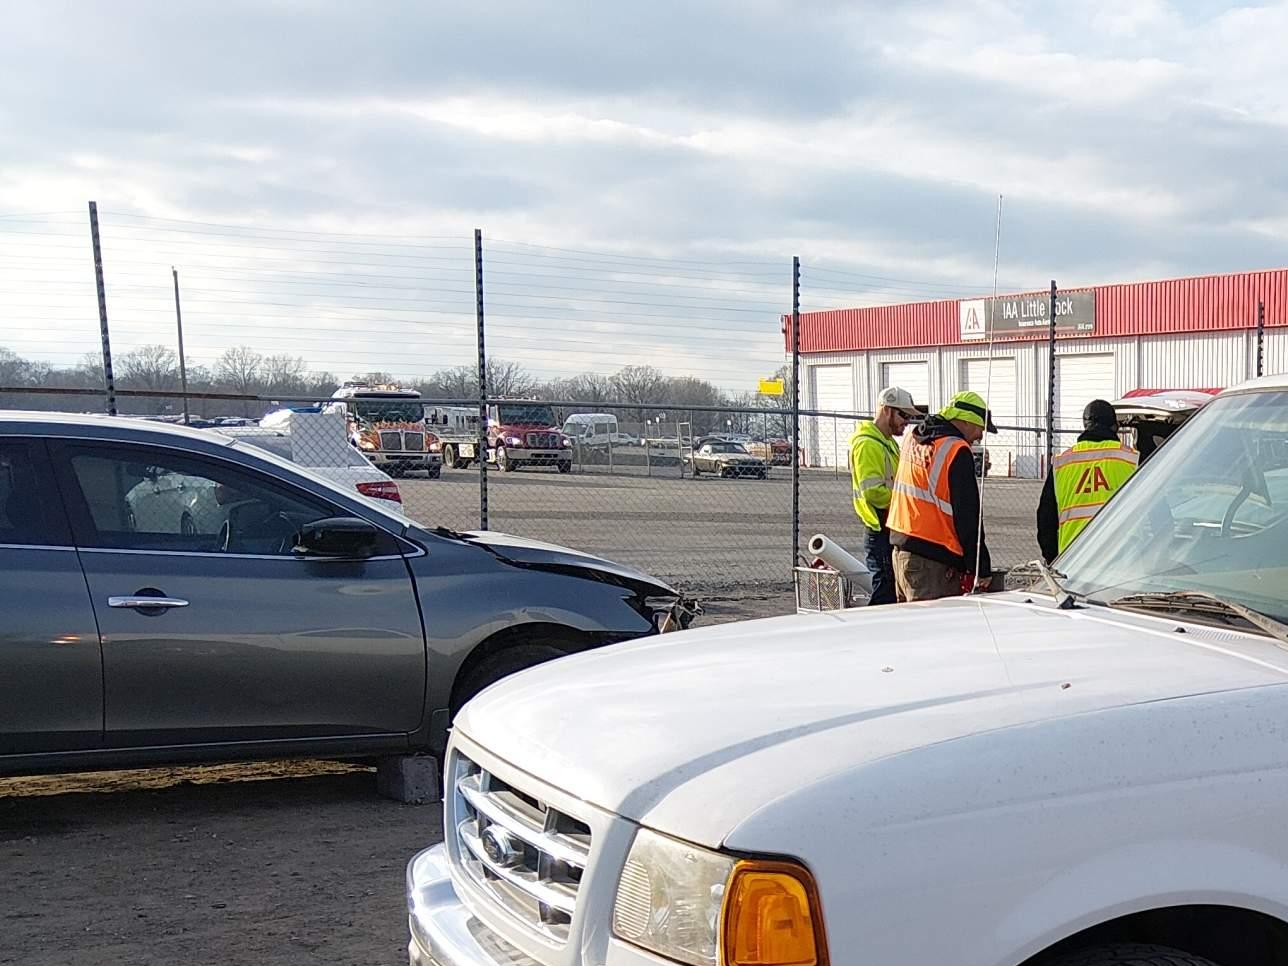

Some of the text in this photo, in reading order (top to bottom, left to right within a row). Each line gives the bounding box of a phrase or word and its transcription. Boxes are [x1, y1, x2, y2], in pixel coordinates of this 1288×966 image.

[1003, 297, 1073, 319] IAA Little ock
